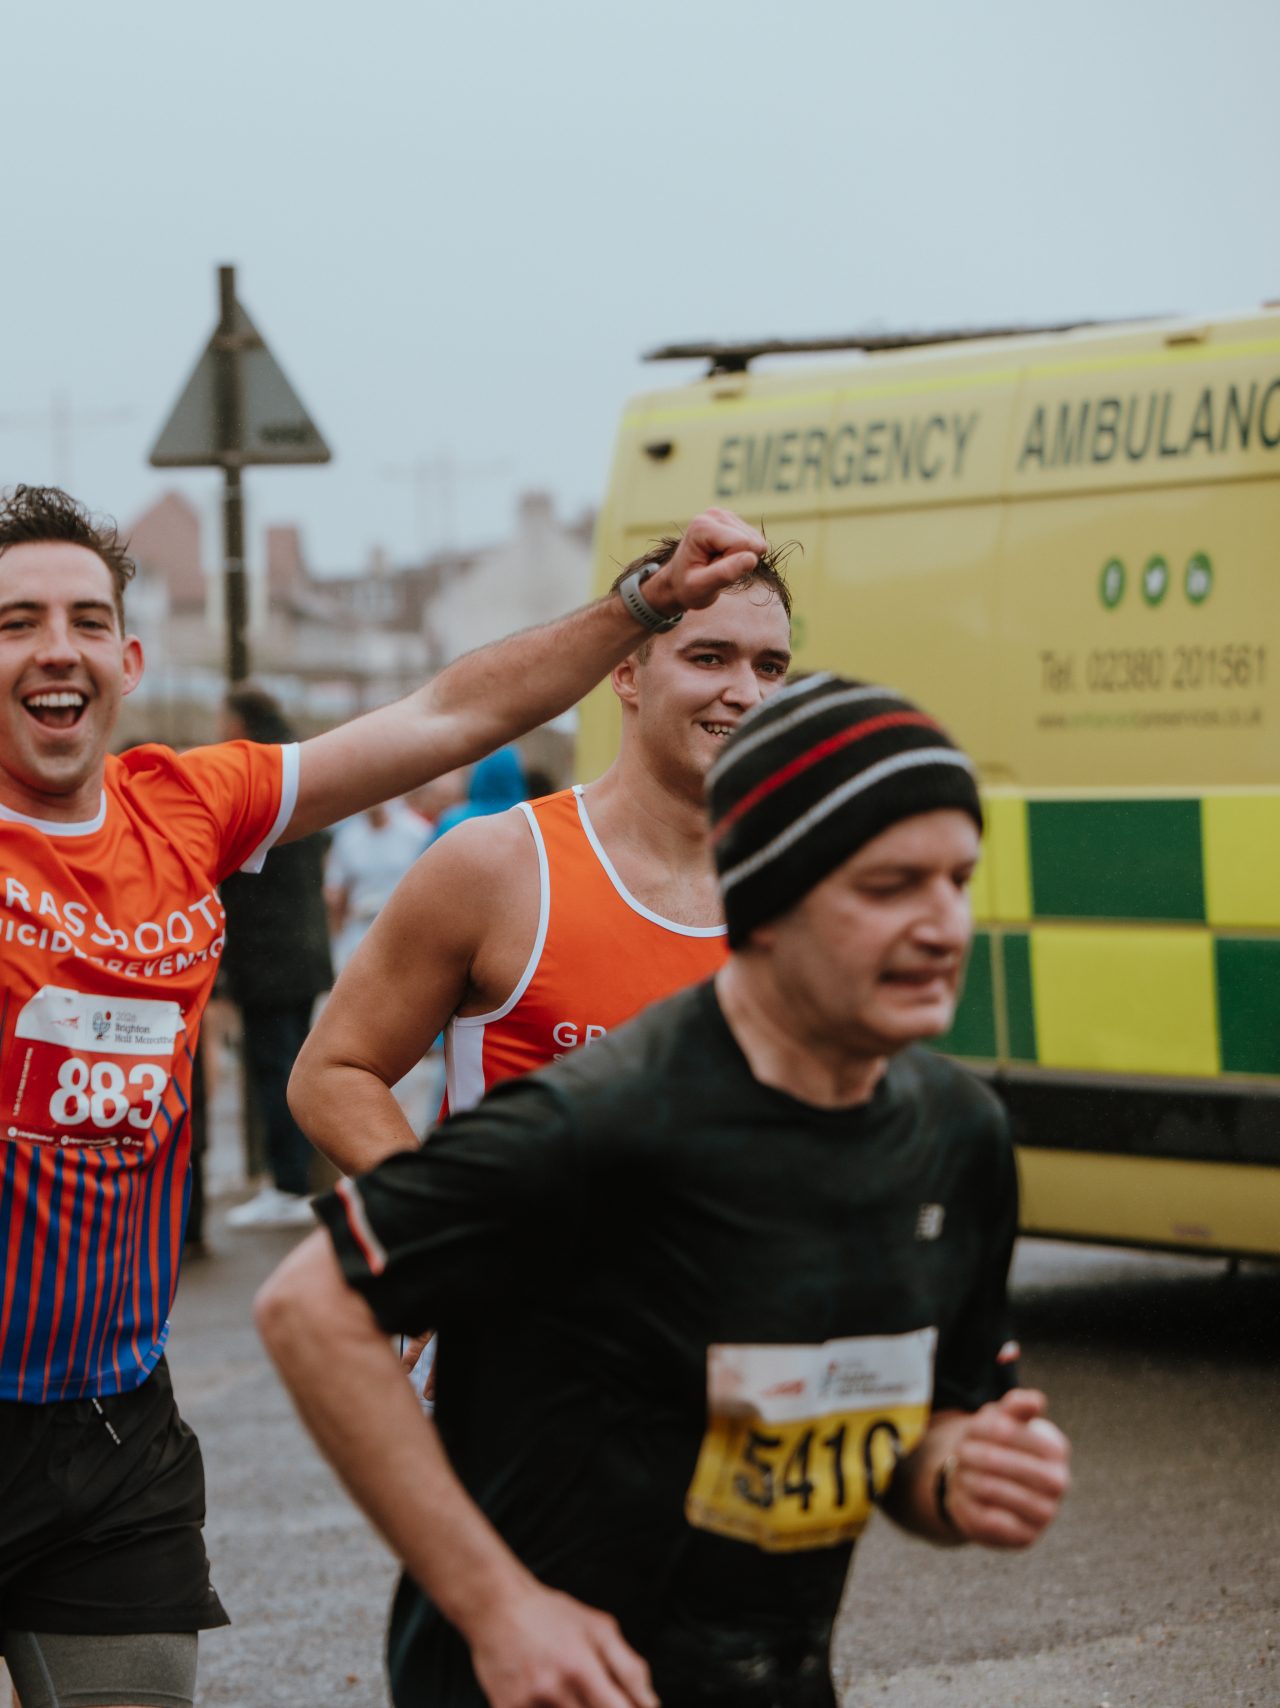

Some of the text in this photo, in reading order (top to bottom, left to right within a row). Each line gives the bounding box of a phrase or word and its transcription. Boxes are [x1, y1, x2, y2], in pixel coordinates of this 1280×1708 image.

[715, 409, 980, 498] EMERGENCY
[115, 1023, 151, 1034] Brighton
[50, 1057, 168, 1130] 883
